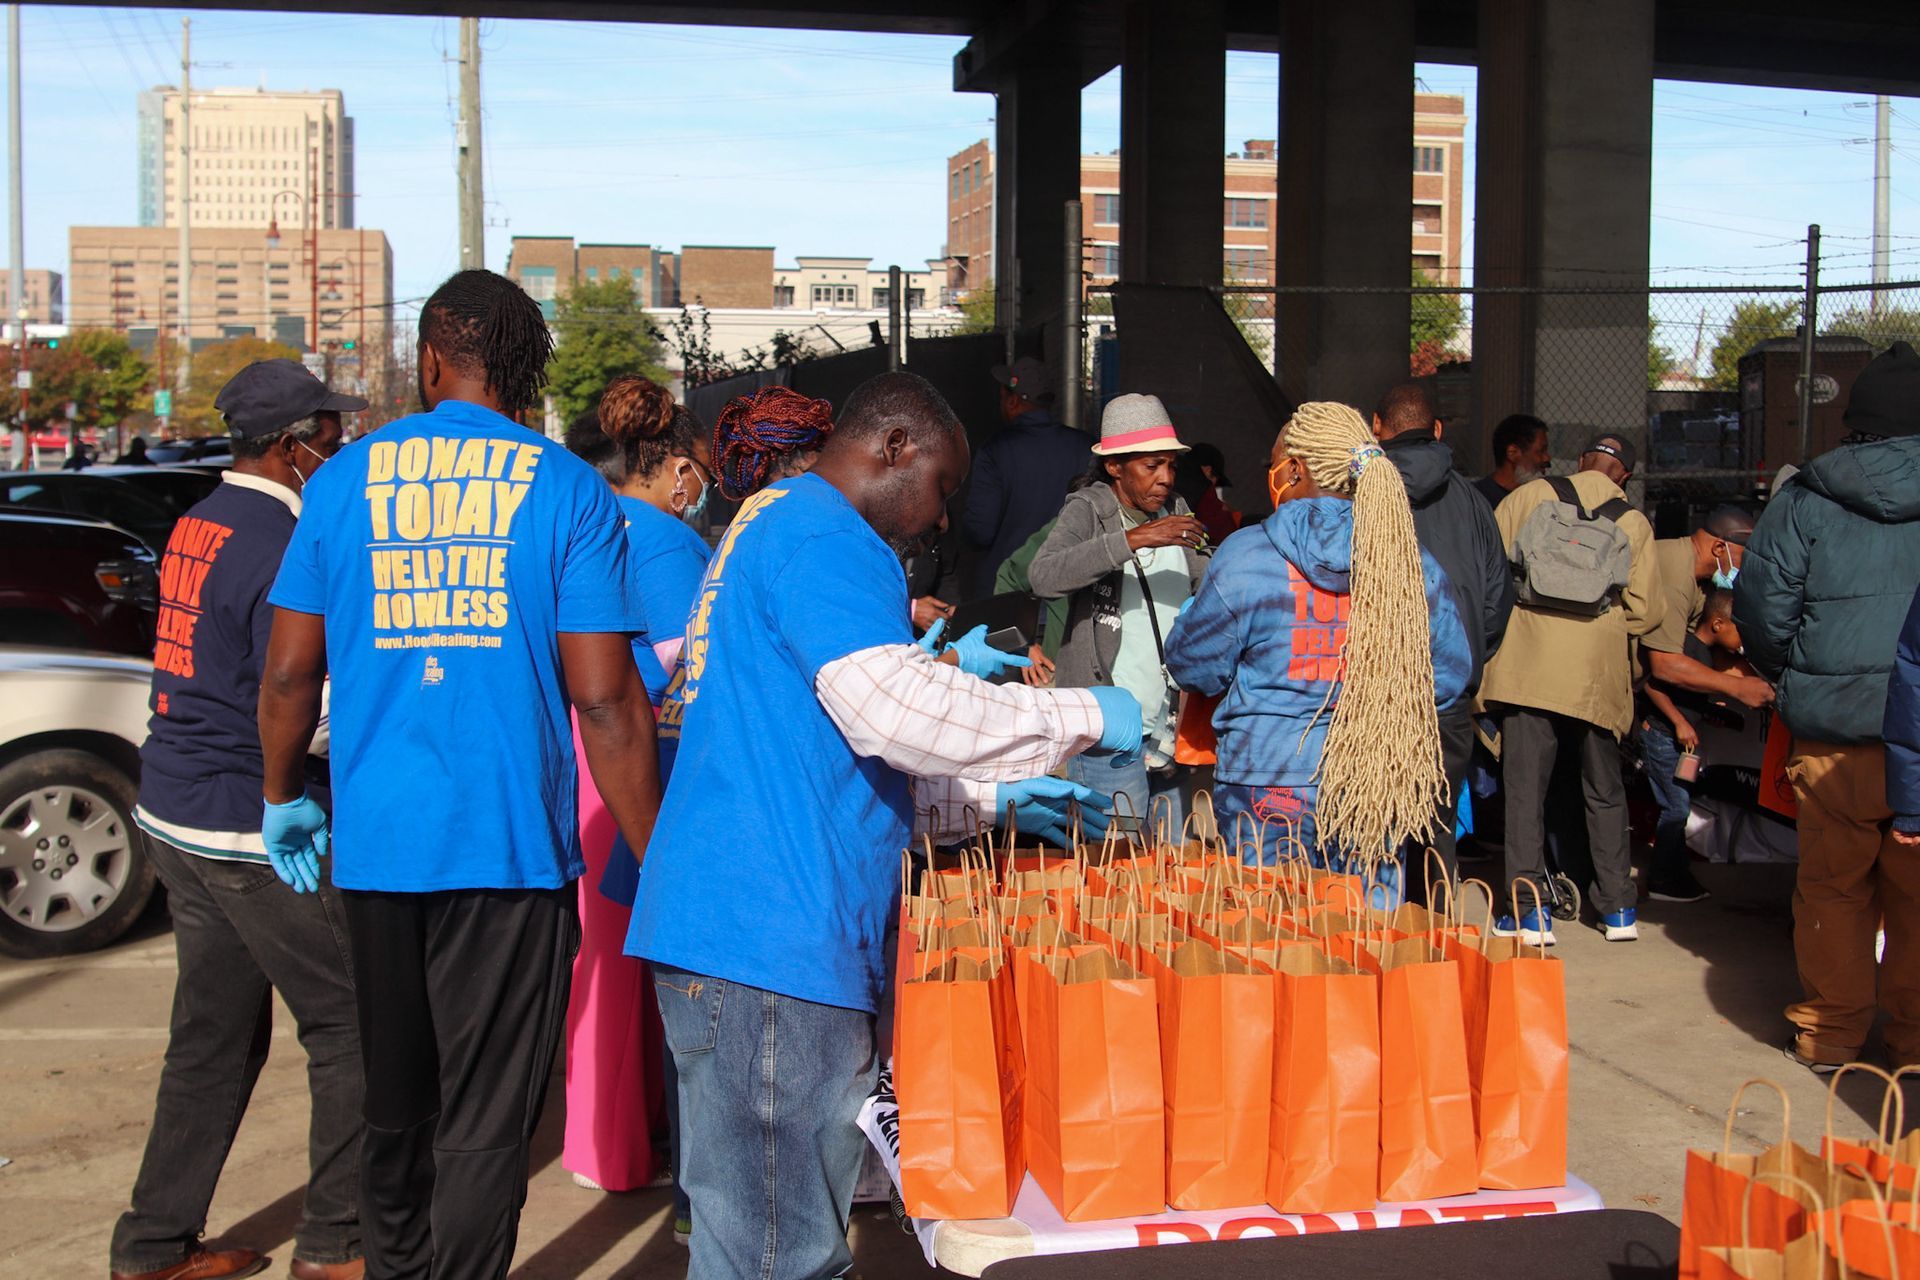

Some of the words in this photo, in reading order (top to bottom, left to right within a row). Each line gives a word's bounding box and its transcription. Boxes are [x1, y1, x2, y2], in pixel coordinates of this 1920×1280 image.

[367, 437, 543, 484] DONATE
[366, 480, 530, 541] TODAY
[371, 548, 445, 590] HELP
[446, 546, 508, 588] THE
